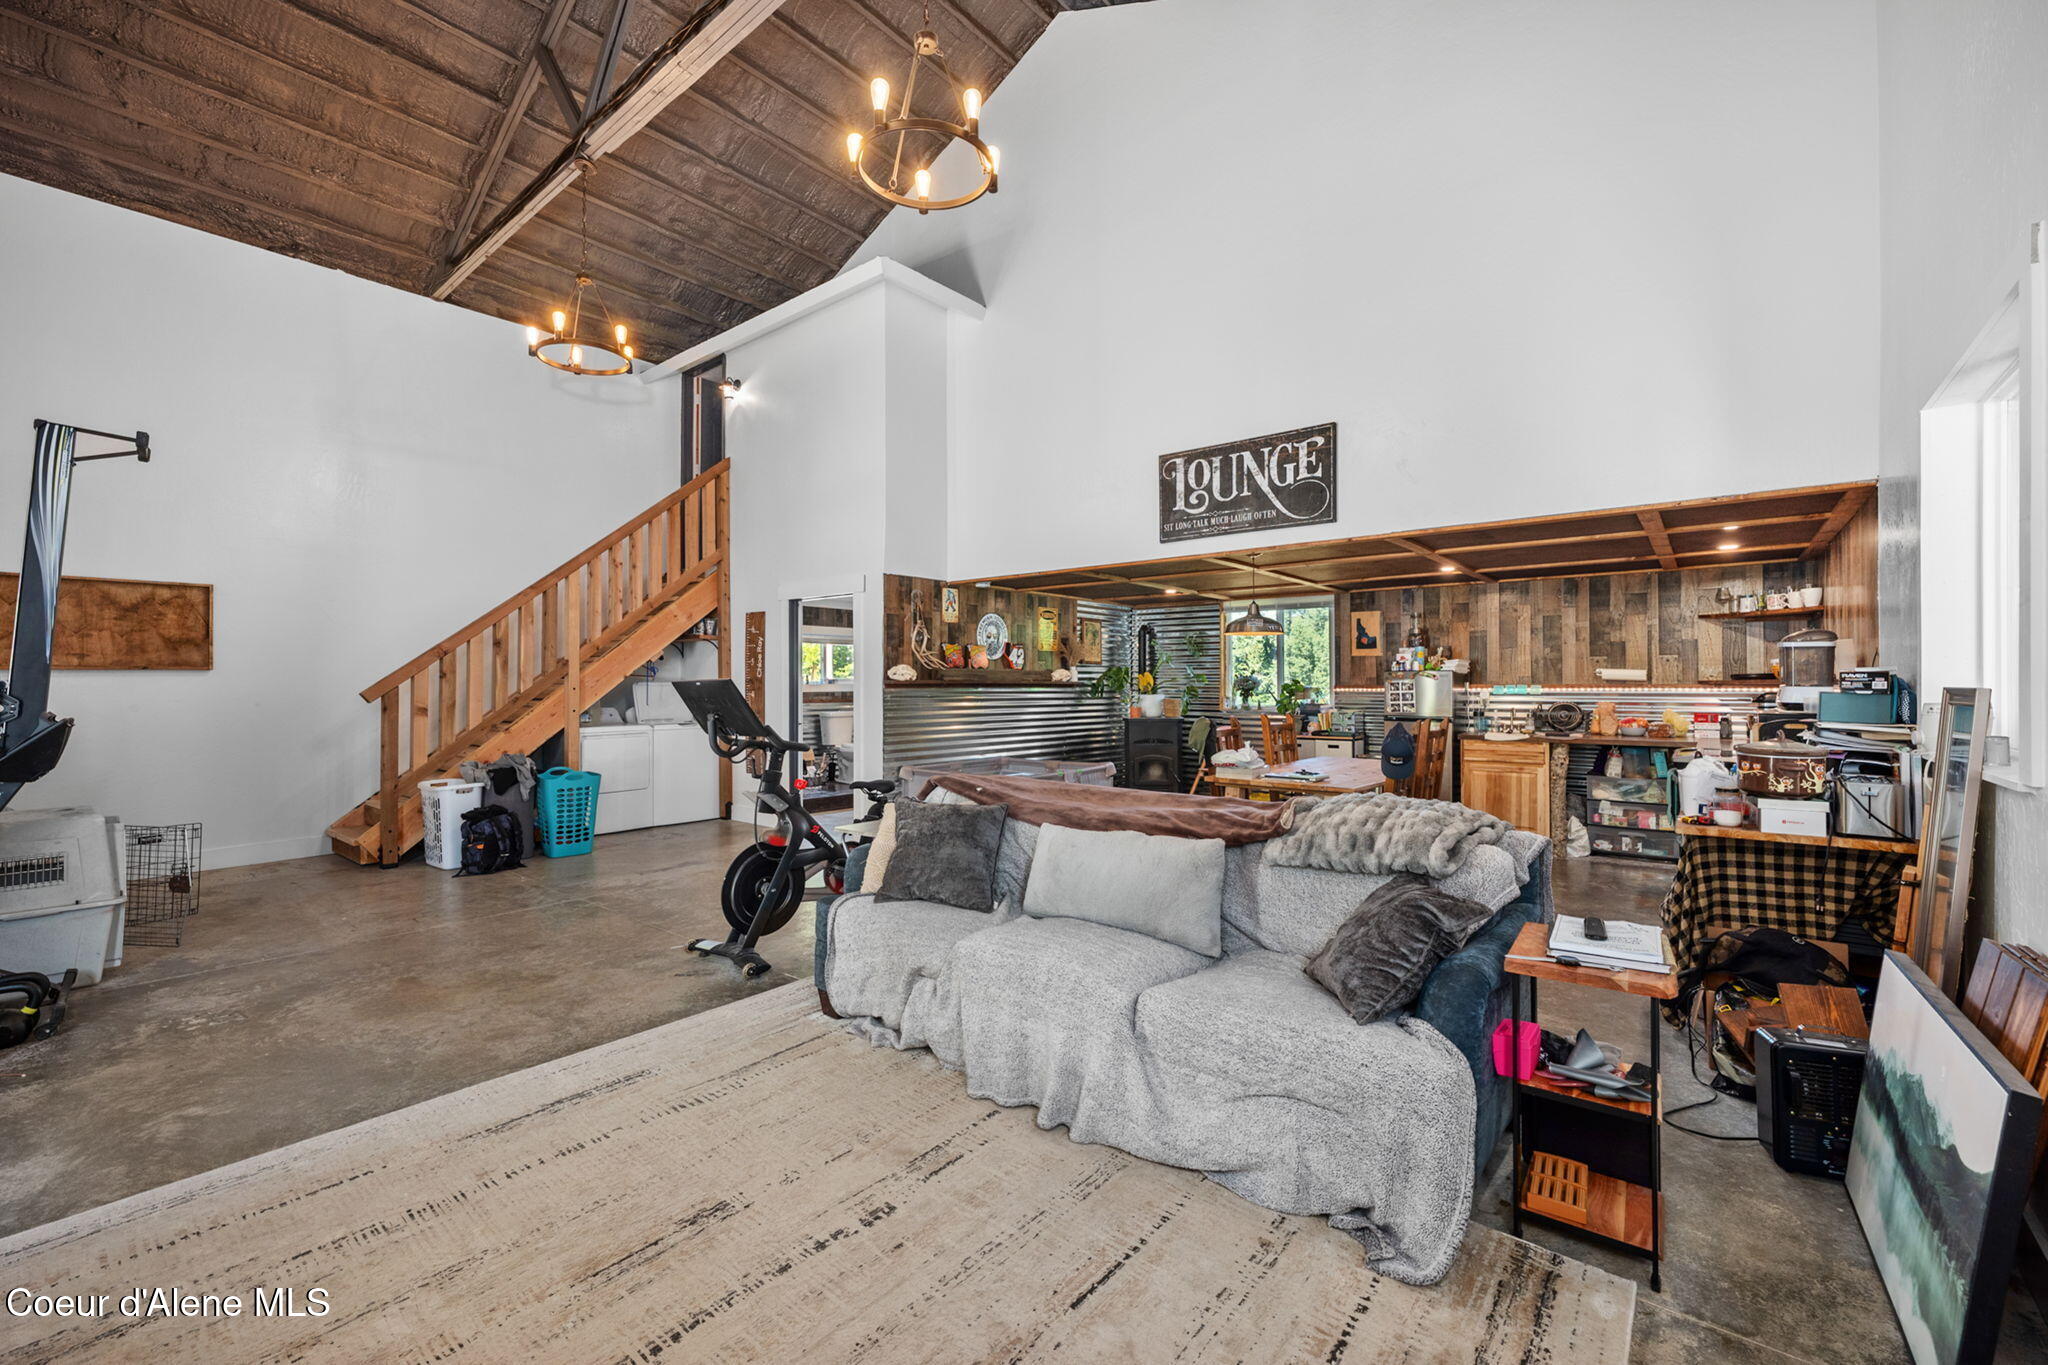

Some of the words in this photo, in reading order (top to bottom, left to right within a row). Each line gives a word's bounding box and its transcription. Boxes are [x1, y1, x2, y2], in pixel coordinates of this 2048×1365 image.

[1162, 436, 1330, 520] LOUNGE
[1163, 523, 1174, 532] SIT
[1253, 509, 1277, 520] OFTEN
